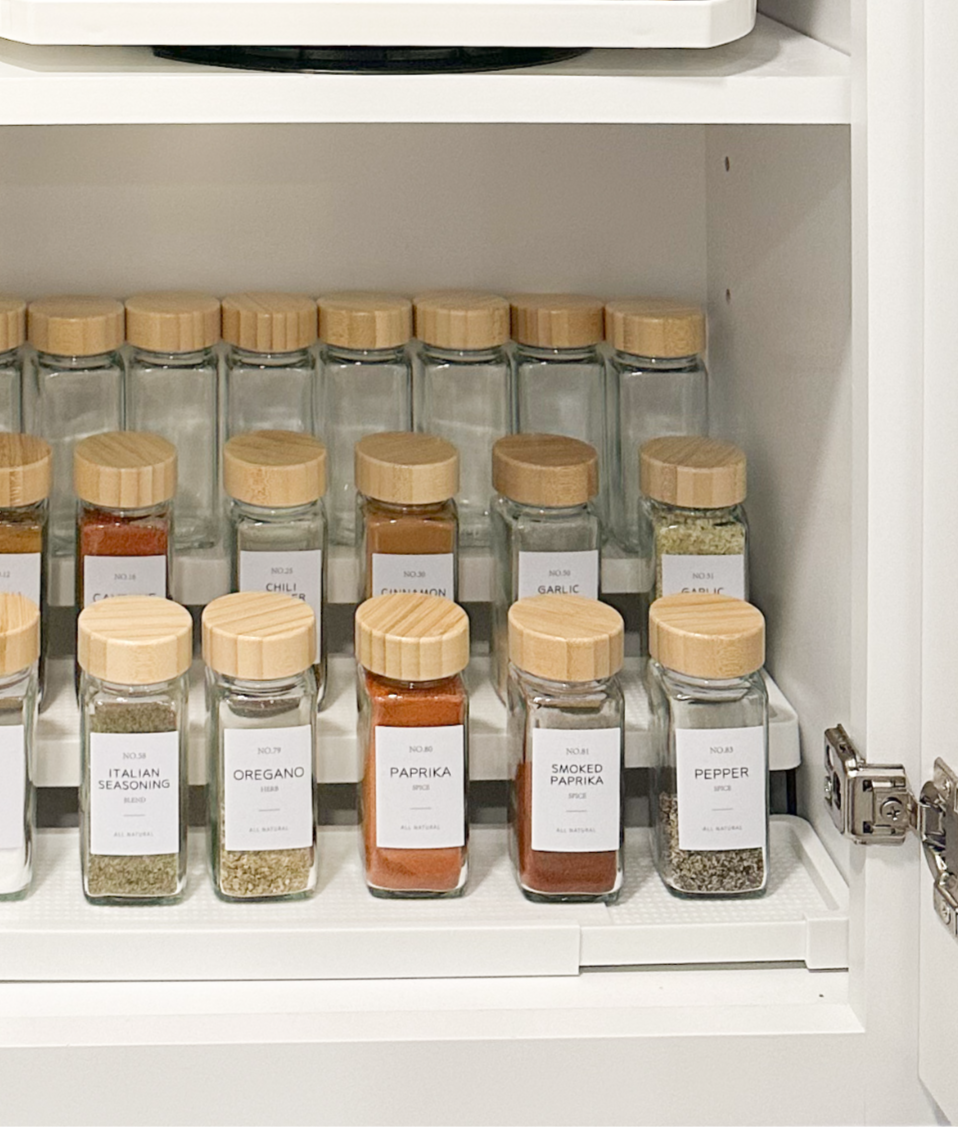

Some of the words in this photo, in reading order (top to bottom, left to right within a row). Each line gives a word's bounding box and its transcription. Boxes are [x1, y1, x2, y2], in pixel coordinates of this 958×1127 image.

[265, 582, 297, 593] CHILI
[537, 584, 579, 594] GARLIC
[109, 768, 160, 778] ITALIAN
[233, 766, 305, 781] OREGANO
[390, 766, 452, 778] PAPRIKA
[551, 763, 603, 774] SMOKED
[694, 766, 749, 780] PEPPER
[98, 778, 171, 791] SEASONING
[550, 775, 604, 786] PAPRIKA
